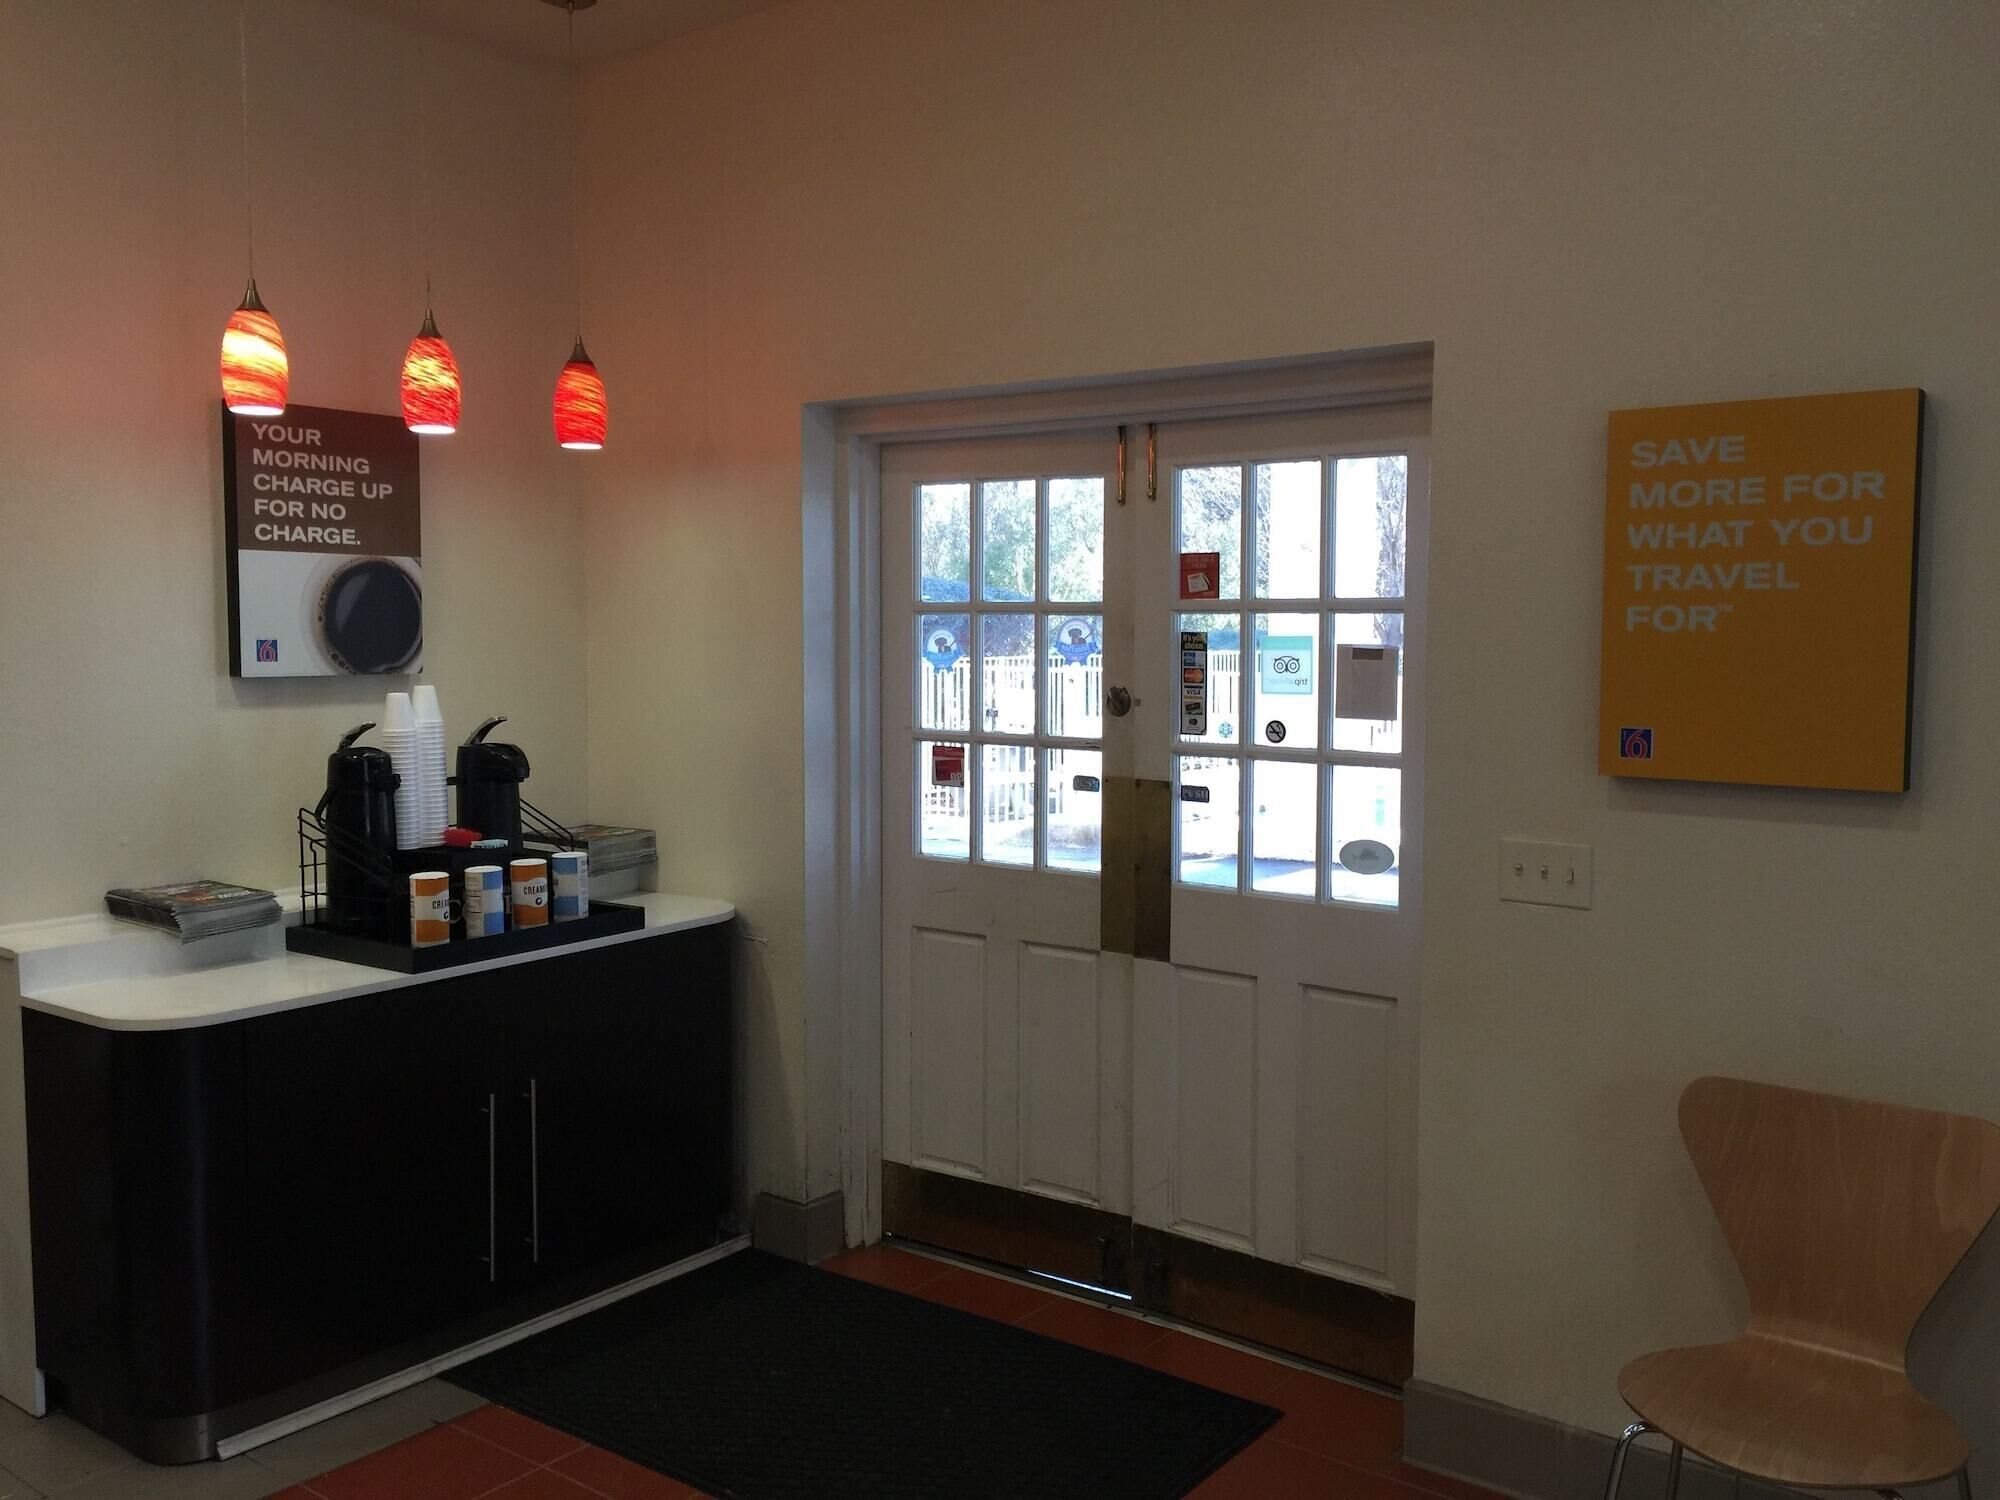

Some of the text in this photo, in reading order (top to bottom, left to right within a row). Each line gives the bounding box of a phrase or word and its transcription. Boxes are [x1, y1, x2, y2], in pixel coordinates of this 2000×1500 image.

[252, 423, 321, 446] YOUR
[253, 449, 370, 474] MORNING
[1631, 436, 1745, 467] SAVE
[253, 474, 393, 500] CHARGE UP
[1630, 471, 1885, 508] MORE FOR
[254, 499, 346, 521] FOR NO
[254, 524, 361, 545] CHARGE.
[1628, 516, 1874, 549] WHAT YOU
[1626, 562, 1799, 592] TRAVEL
[258, 640, 276, 662] 6
[1624, 728, 1649, 758] 6
